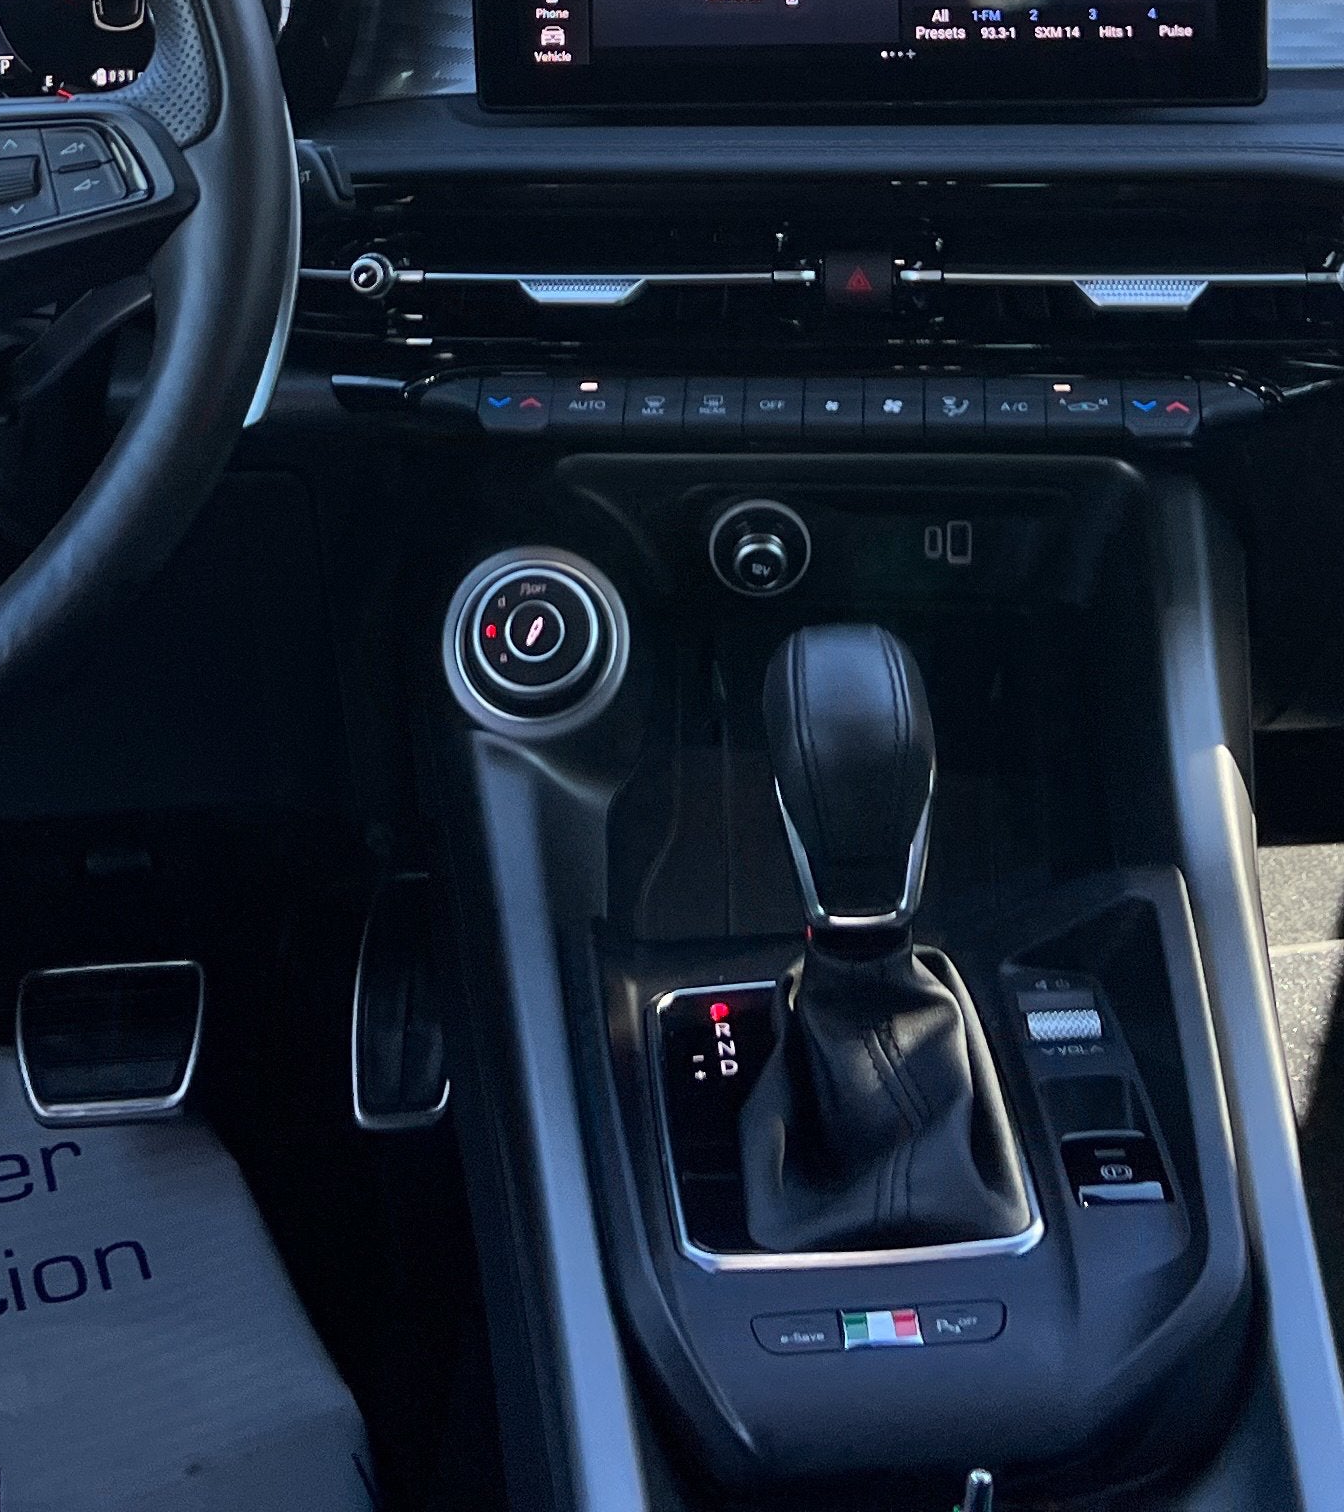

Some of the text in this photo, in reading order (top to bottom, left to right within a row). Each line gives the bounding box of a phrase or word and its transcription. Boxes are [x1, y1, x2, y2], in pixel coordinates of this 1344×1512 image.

[535, 8, 570, 19] Phone
[932, 9, 950, 23] All
[971, 9, 1001, 22] 1-FM
[1029, 9, 1039, 21] 2
[1088, 8, 1098, 21] 3
[1147, 7, 1157, 20] 4
[915, 26, 966, 41] Presets
[980, 26, 1017, 39] 93.3-1
[1034, 25, 1081, 39] SXM 14
[1099, 25, 1133, 38] Hits 1
[1158, 24, 1194, 38] Pulse
[533, 50, 572, 63] Vehicle
[0, 59, 10, 75] P
[45, 75, 54, 87] E
[568, 399, 606, 410] AUTO
[641, 406, 665, 415] MAX
[699, 406, 726, 415] REAR
[760, 399, 785, 410] OFF
[1001, 401, 1028, 412] A/C
[715, 1022, 731, 1039] R
[717, 1039, 736, 1057] N
[720, 1059, 739, 1077] D
